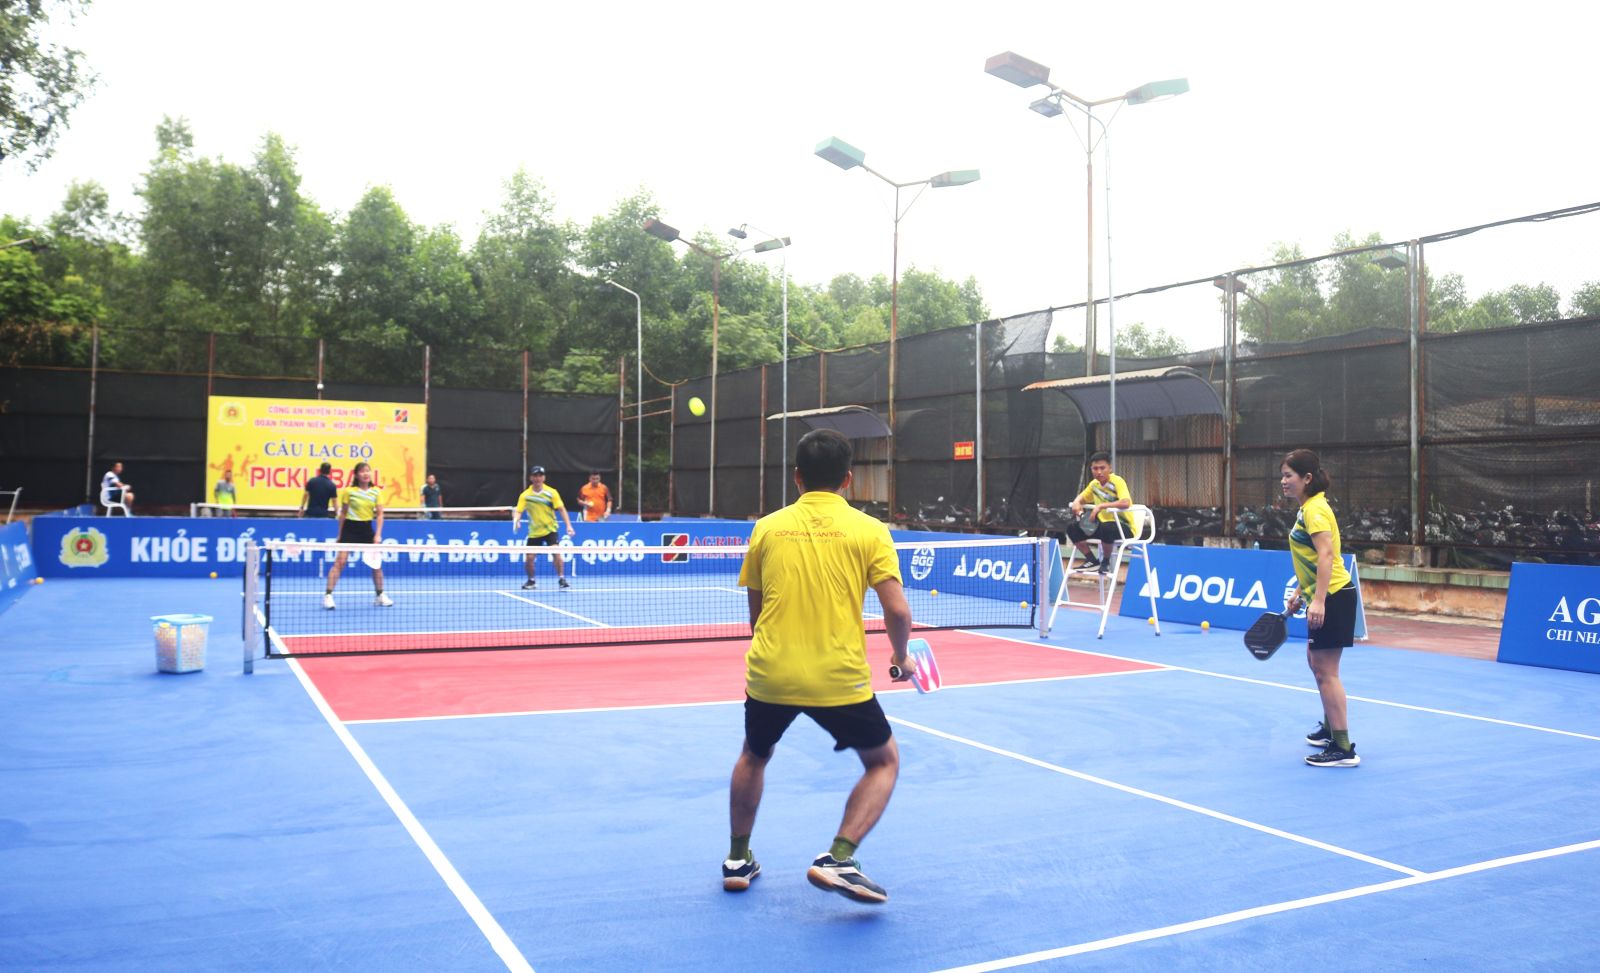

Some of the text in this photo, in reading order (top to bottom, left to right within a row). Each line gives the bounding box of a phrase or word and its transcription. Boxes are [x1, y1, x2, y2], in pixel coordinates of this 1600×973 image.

[264, 439, 374, 462] CÂU LẠC BỘ
[130, 528, 208, 562] KHỎE
[911, 555, 935, 567] BGG
[968, 558, 1030, 584] JOOLA
[1162, 573, 1268, 609] JOOLA
[1546, 628, 1600, 644] CHI NH
